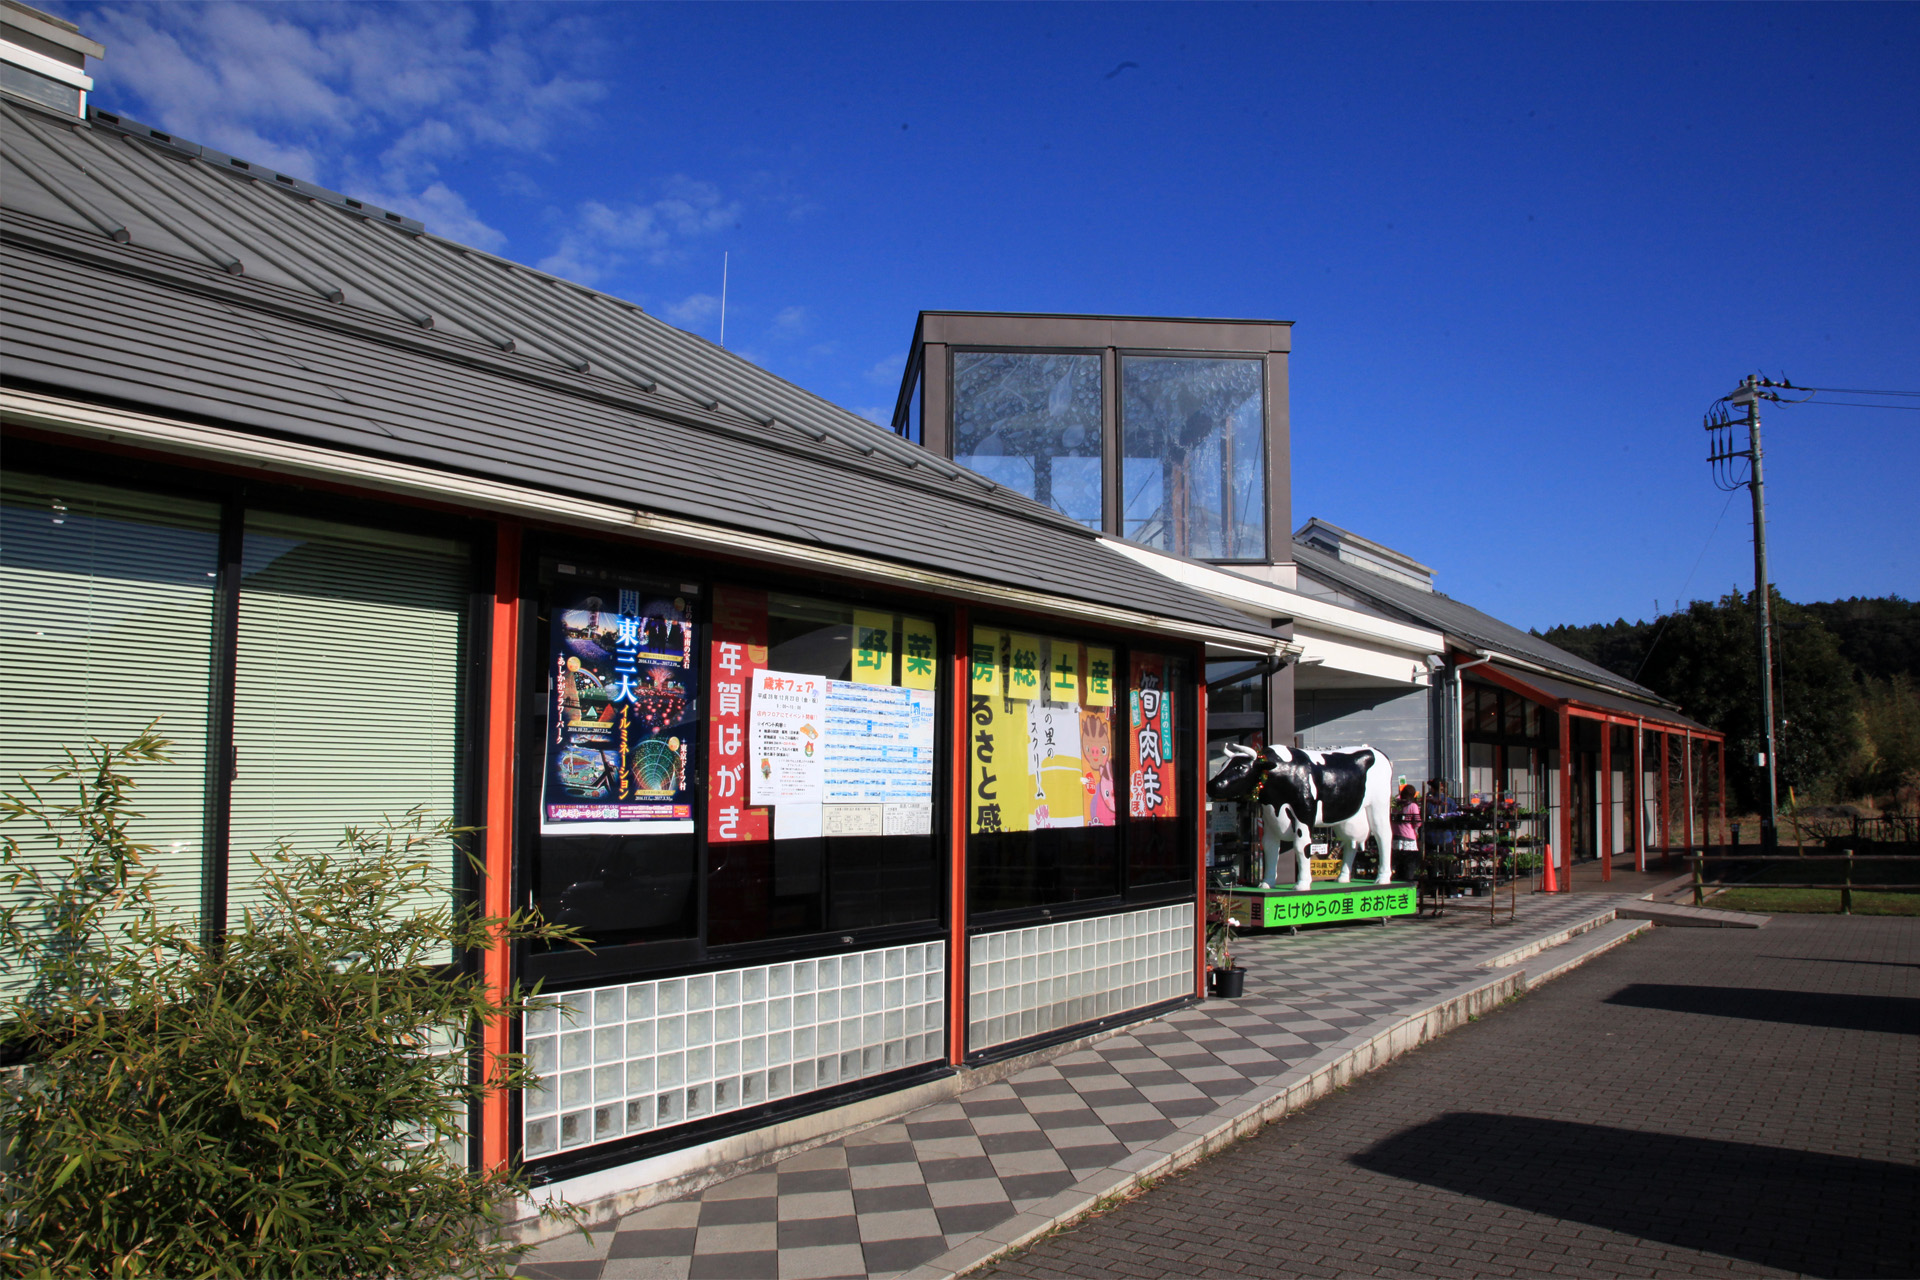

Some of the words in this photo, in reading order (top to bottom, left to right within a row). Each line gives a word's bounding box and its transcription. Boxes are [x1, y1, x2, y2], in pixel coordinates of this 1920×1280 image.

[614, 588, 640, 703] 関東三大
[764, 676, 814, 693] 歳末フェア
[857, 628, 932, 675] 野菜
[973, 644, 1110, 695] 房総土産
[618, 704, 631, 800] イルミネーション
[717, 641, 745, 839] 年賀はがき
[1030, 699, 1044, 797] イスクリーム
[1139, 670, 1161, 840] 筍肉ま
[1273, 898, 1354, 920] たけゆらの里
[1360, 894, 1409, 913] おおたき
